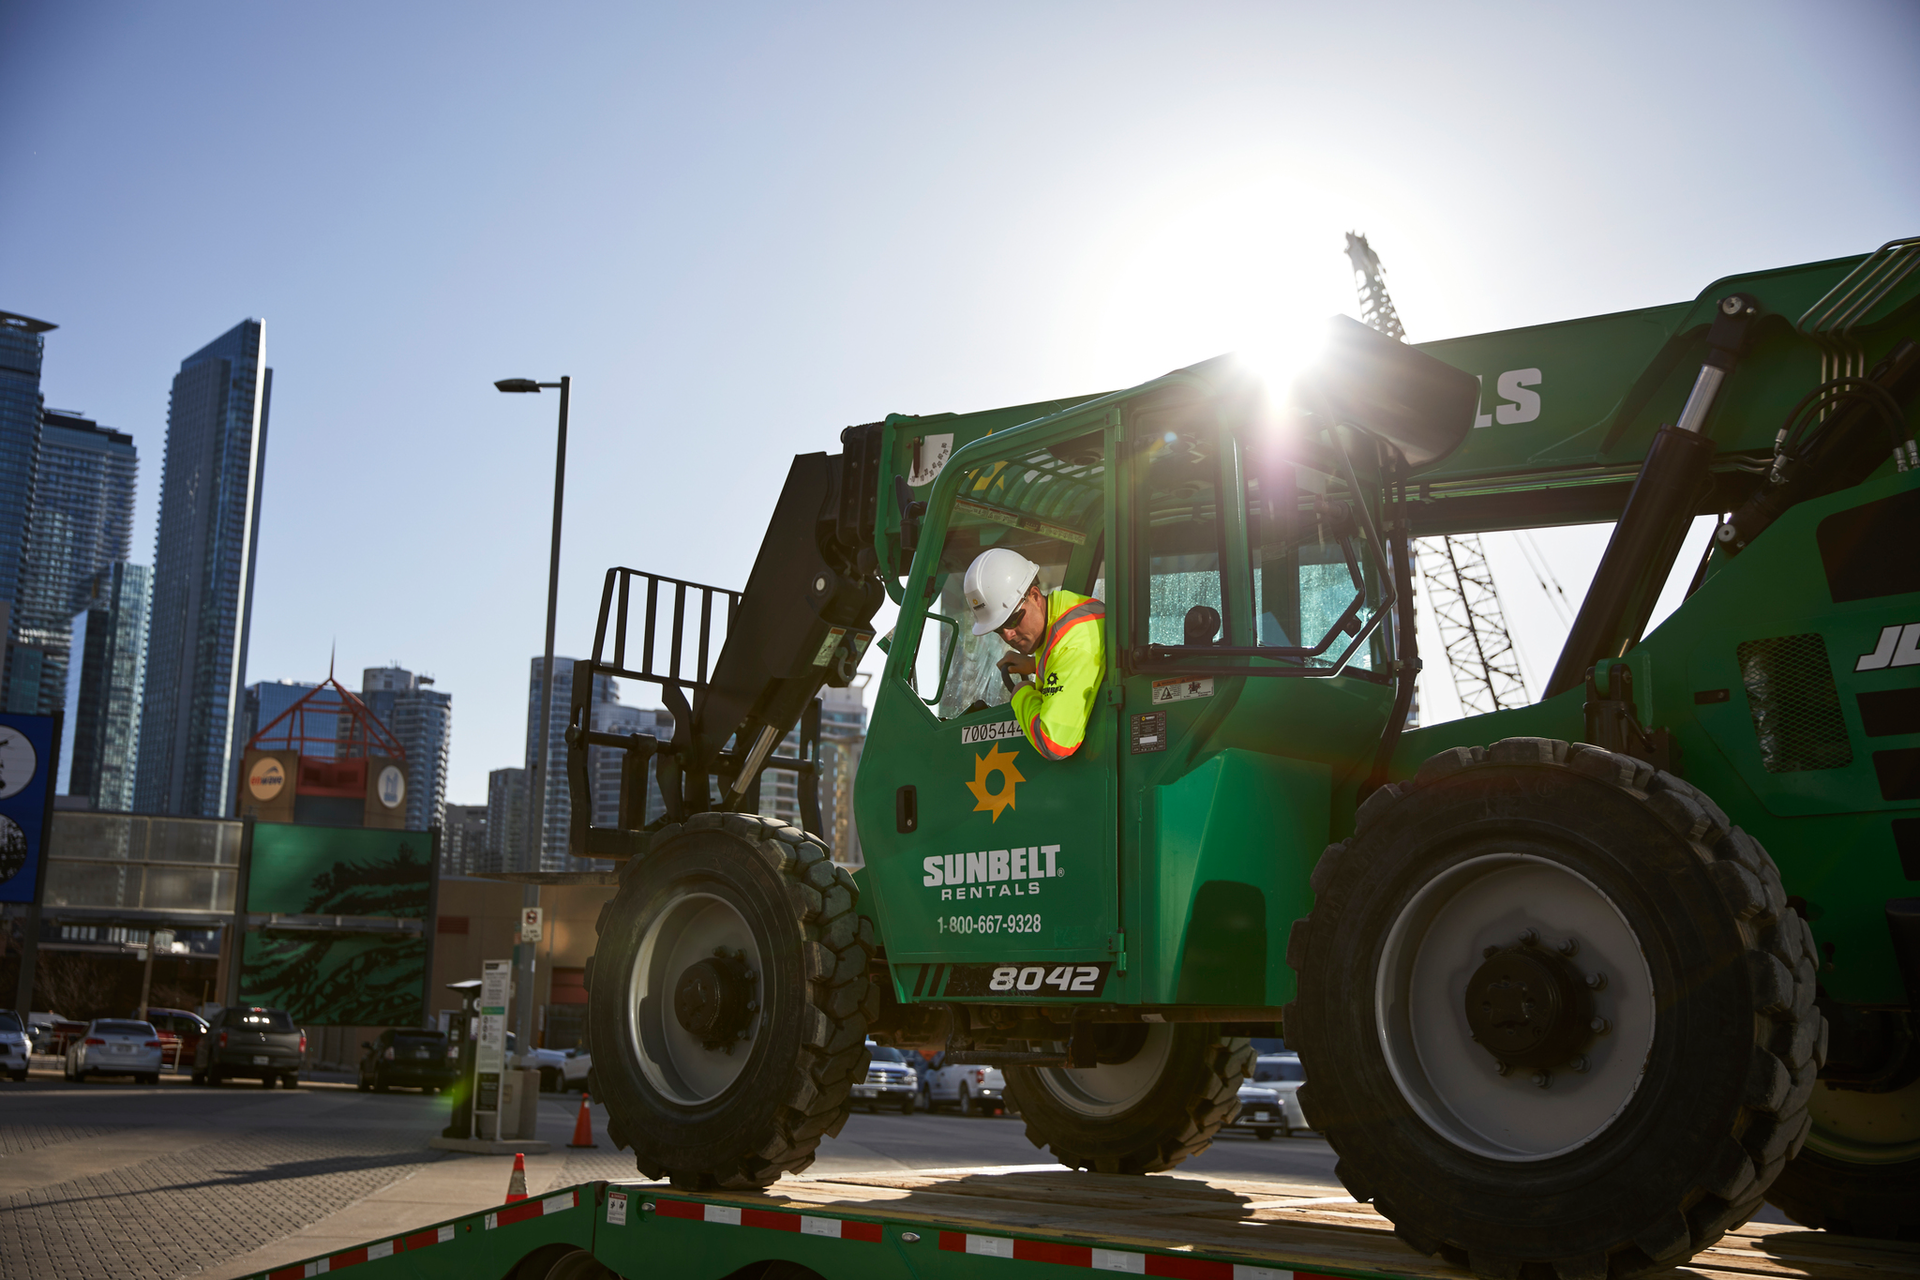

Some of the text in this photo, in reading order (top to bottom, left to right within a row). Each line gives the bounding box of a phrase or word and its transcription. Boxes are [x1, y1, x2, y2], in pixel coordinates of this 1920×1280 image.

[941, 882, 1040, 901] RENTALS
[937, 914, 1042, 935] 1-800-667-9328
[989, 966, 1100, 991] 8042
